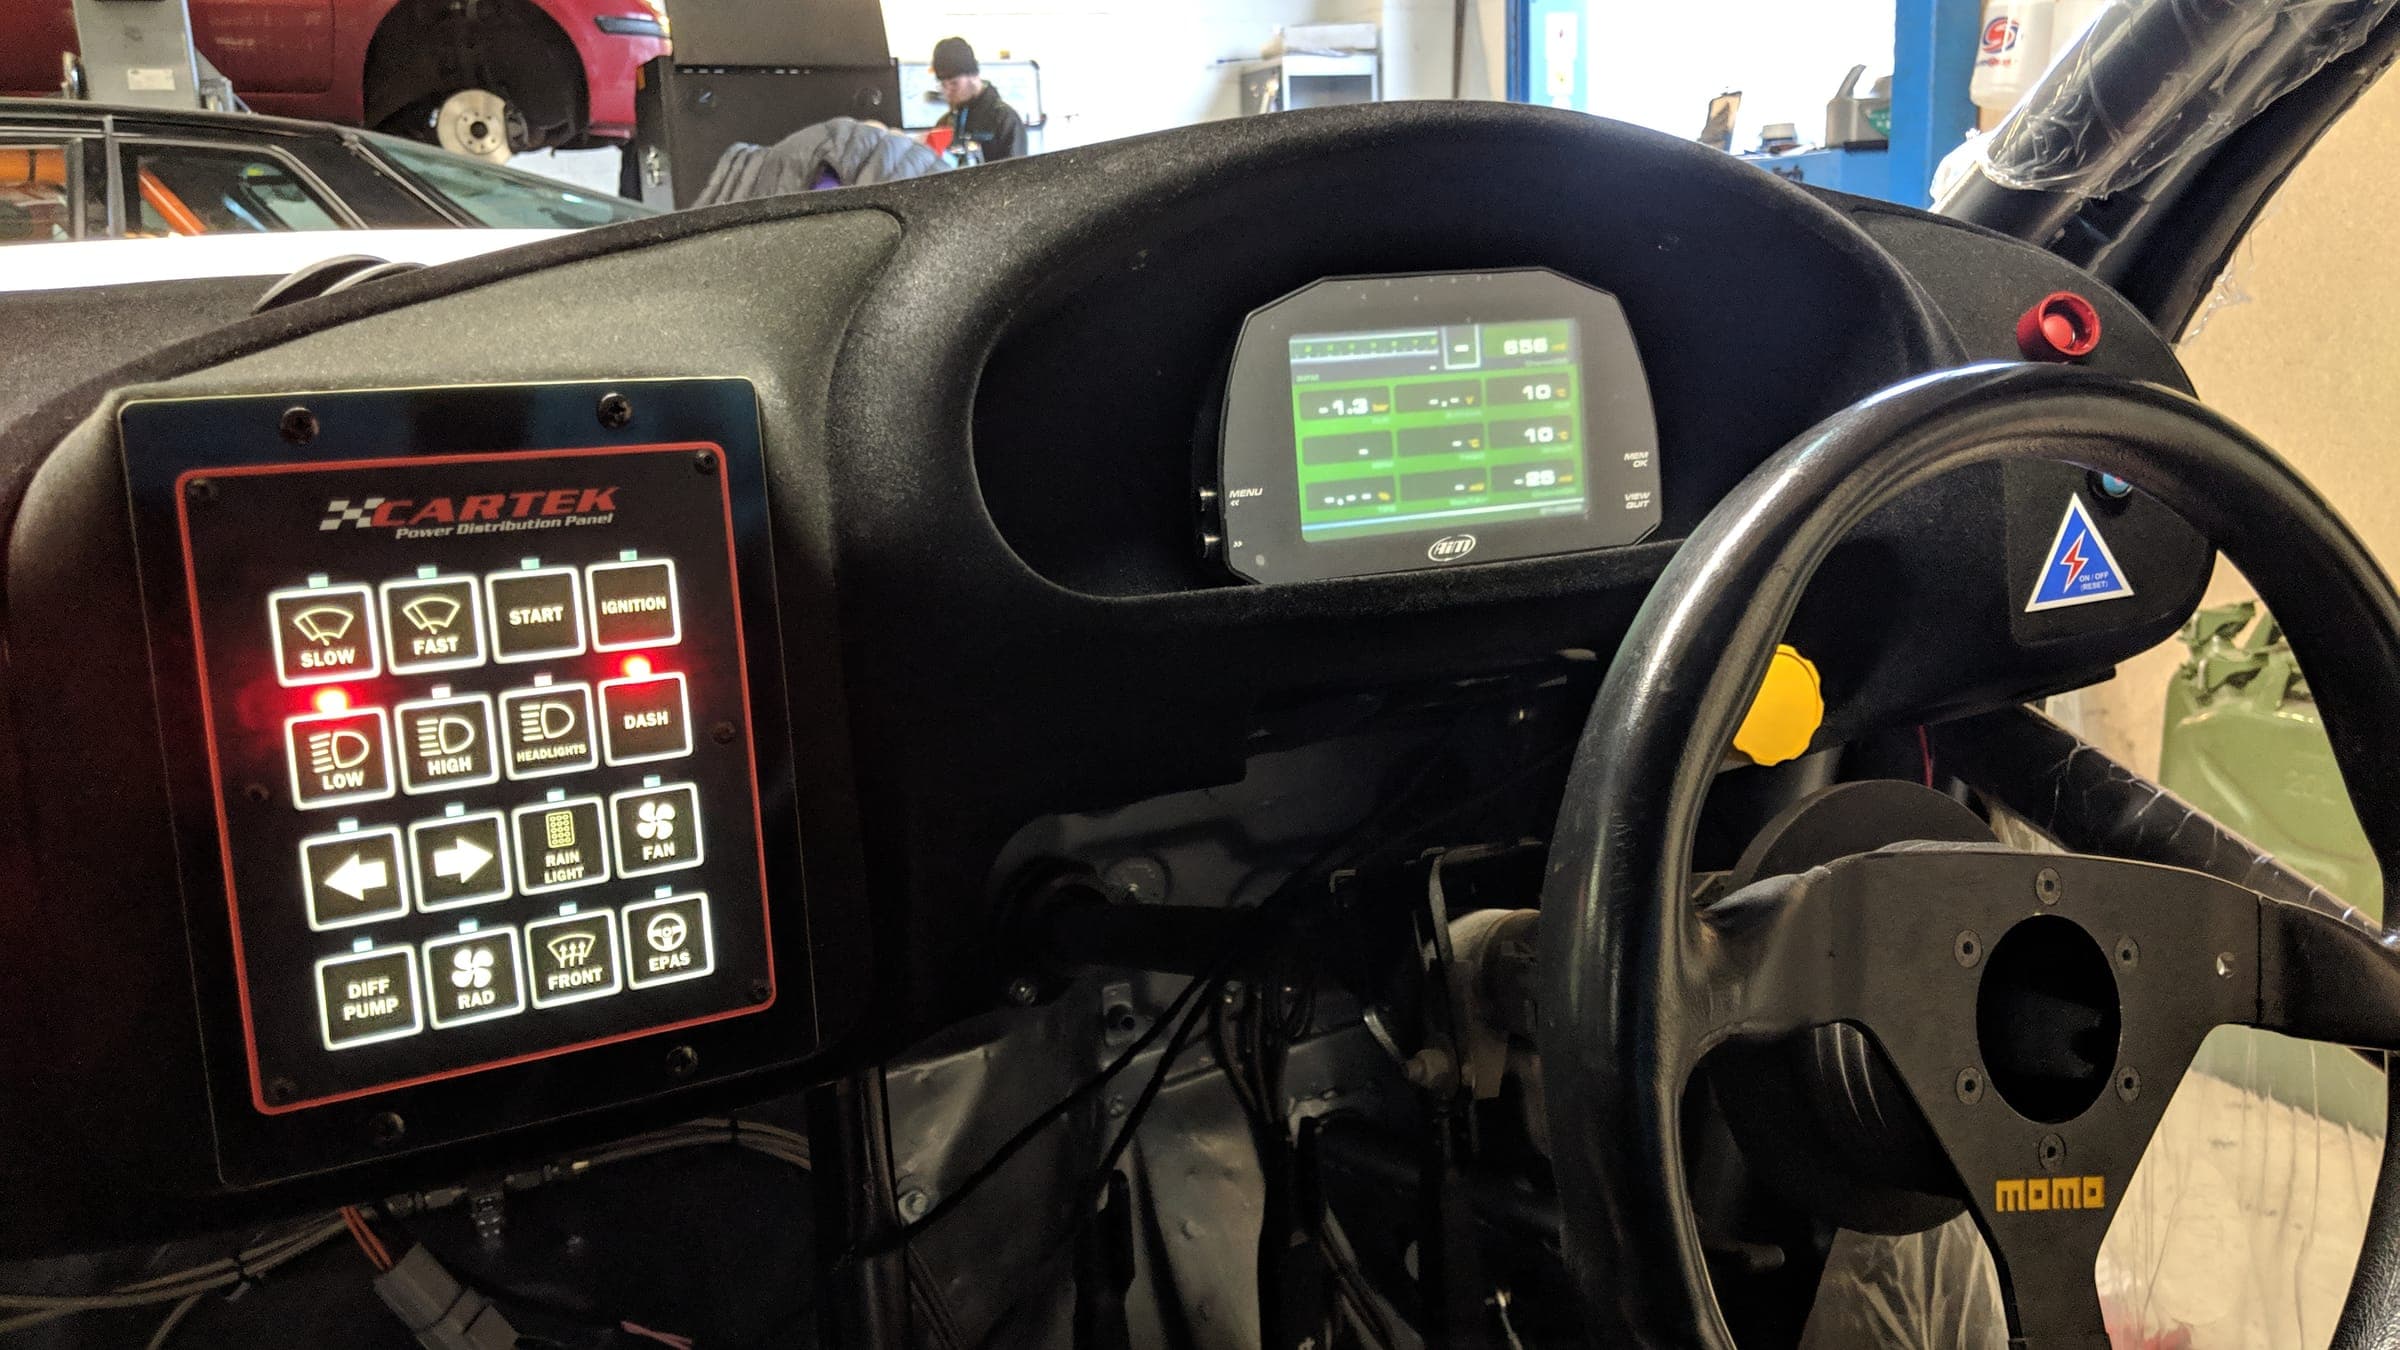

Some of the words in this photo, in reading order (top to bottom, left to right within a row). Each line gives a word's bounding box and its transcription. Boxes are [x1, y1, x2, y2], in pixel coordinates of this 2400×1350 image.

[1503, 337, 1548, 355] 656
[1522, 384, 1552, 400] 10
[1524, 426, 1554, 443] 10
[1632, 460, 1649, 468] OK
[1229, 488, 1263, 498] MENU
[371, 487, 620, 527] CARTEK
[395, 526, 454, 540] Power
[456, 516, 561, 535] Distribution
[565, 512, 614, 526] Panel
[2079, 574, 2090, 582] ON
[2095, 571, 2108, 580] OFF
[601, 596, 667, 615] IGNITION
[509, 606, 564, 626] START
[413, 636, 459, 655] FAST
[300, 648, 355, 668] SLOW
[623, 711, 669, 730] DASH
[517, 744, 586, 762] HEADLIGHTS
[427, 756, 473, 776] HIGH
[322, 771, 364, 790] LOW
[545, 850, 581, 868] RAIN
[642, 842, 676, 860] FAN
[544, 865, 585, 884] LIGHT
[648, 951, 692, 972] EPAS
[548, 967, 603, 990] FRONT
[347, 978, 390, 999] DIFF
[343, 997, 399, 1021] PUMP
[457, 990, 496, 1010] RAD
